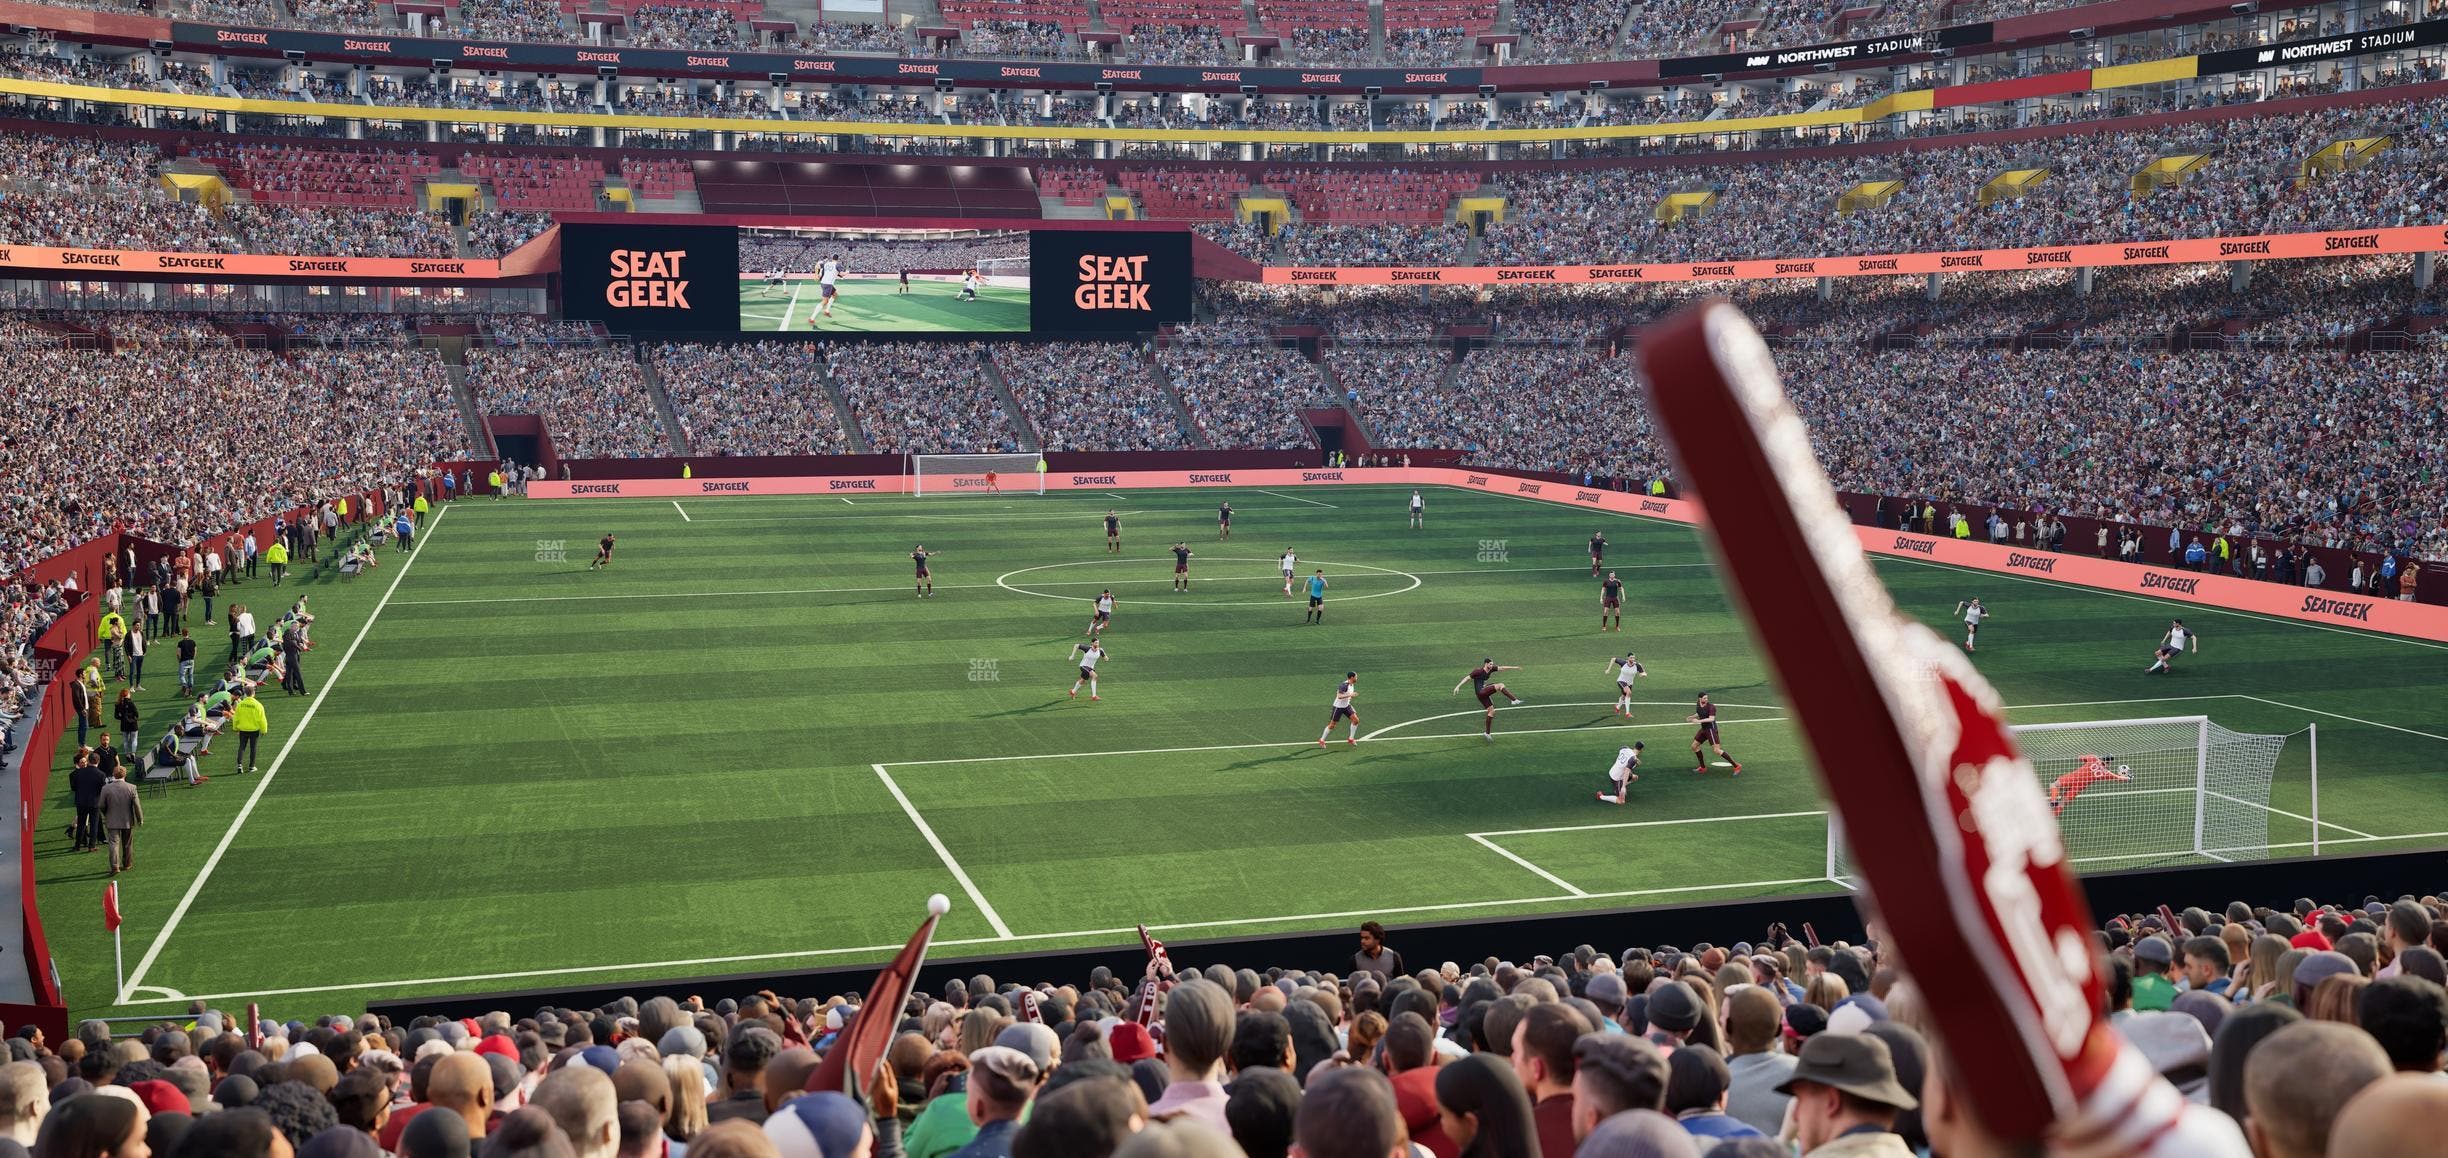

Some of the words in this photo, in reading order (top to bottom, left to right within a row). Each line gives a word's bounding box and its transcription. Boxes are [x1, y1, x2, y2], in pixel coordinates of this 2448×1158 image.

[217, 31, 267, 44] SEATGEEK
[345, 40, 391, 52] SEATGEEK
[1778, 46, 1857, 64] NORTHWEST
[1867, 37, 1922, 54] STADIUM
[2282, 39, 2353, 60] NORTHWEST
[2361, 30, 2415, 49] STADIUM
[464, 46, 507, 58] SEATGEEK
[577, 52, 620, 62] SEATGEEK
[688, 56, 728, 67] SEATGEEK
[795, 60, 834, 71] SEATGEEK
[899, 64, 938, 74] SEATGEEK
[1002, 67, 1040, 77] SEATGEEK
[1103, 70, 1141, 79] SEATGEEK
[1203, 72, 1240, 81] SEATGEEK
[1302, 74, 1341, 83] SEATGEEK
[1406, 73, 1447, 82] SEATGEEK
[2220, 240, 2270, 255] SEATGEEK
[2325, 234, 2378, 250] SEATGEEK
[2028, 251, 2071, 264] SEATGEEK
[2124, 246, 2168, 260] SEATGEEK
[63, 253, 120, 266] SEATGEEK
[159, 257, 224, 269] SEATGEEK
[610, 249, 687, 278] SEAT
[1859, 259, 1897, 271] SEATGEEK
[1942, 255, 1982, 267] SEATGEEK
[290, 261, 347, 272] SEATGEEK
[411, 263, 464, 273] SEATGEEK
[1079, 254, 1149, 281] SEAT
[1693, 266, 1734, 276] SEATGEEK
[1776, 263, 1814, 273] SEATGEEK
[1292, 271, 1336, 280] SEATGEEK
[1392, 271, 1440, 280] SEATGEEK
[1498, 270, 1555, 280] SEATGEEK
[1590, 268, 1642, 278] SEATGEEK
[606, 280, 691, 309] GEEK
[1075, 283, 1152, 311] GEEK
[1073, 476, 1116, 485] SEATGEEK
[1190, 474, 1231, 483] SEATGEEK
[1303, 472, 1343, 481] SEATGEEK
[1467, 475, 1488, 487] SEATGEEK
[572, 484, 619, 494] SEATGEEK
[703, 482, 749, 491] SEATGEEK
[830, 480, 875, 489] SEATGEEK
[1518, 482, 1541, 495] SEATGEEK
[1576, 490, 1602, 504] SEATGEEK
[1640, 499, 1669, 514] SEATGEEK
[1893, 536, 1937, 555] SEATGEEK
[2006, 552, 2057, 574] SEATGEEK
[2140, 570, 2200, 595] SEATGEEK
[2301, 594, 2374, 622] SEATGEEK
